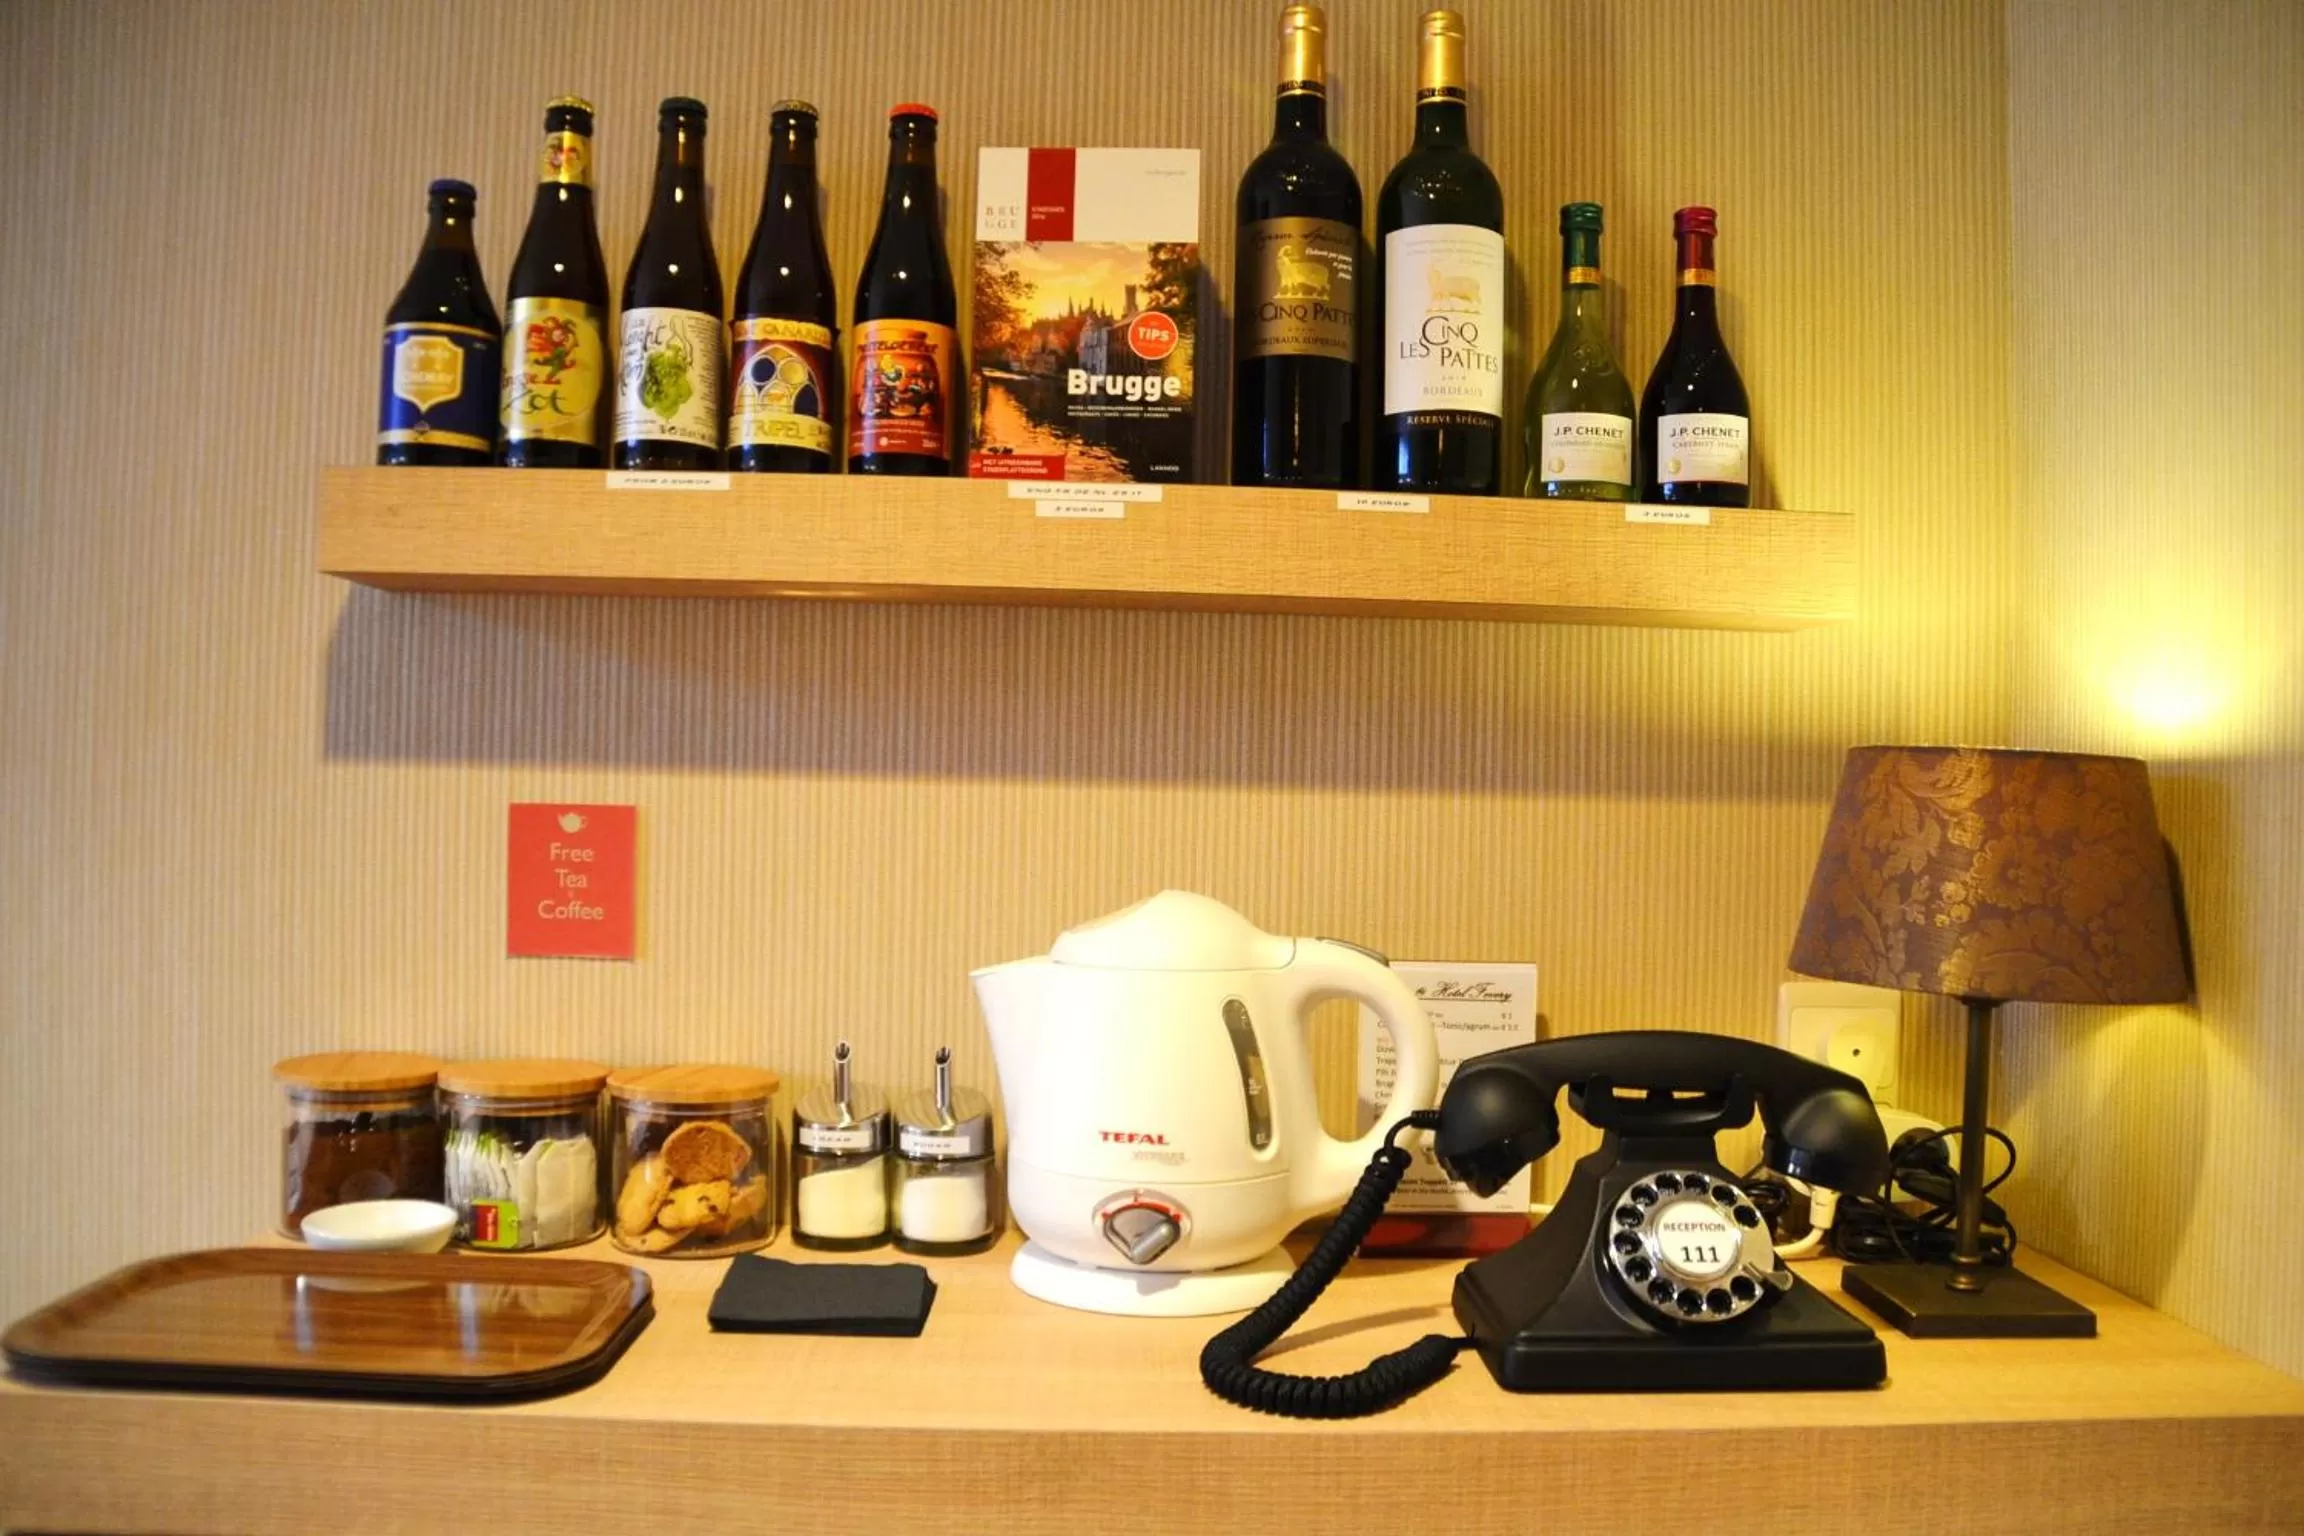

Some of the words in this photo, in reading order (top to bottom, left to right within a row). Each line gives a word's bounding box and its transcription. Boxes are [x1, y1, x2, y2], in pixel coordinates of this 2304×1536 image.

[1259, 302, 1308, 323] CINQ
[1138, 327, 1169, 342] TIPS
[1421, 315, 1479, 348] CINQ
[1400, 336, 1430, 359] LES
[1441, 347, 1498, 374] PATTES
[1067, 368, 1182, 402] Brugge
[1554, 427, 1572, 437] J.P.
[1576, 426, 1624, 439] CHENET
[1670, 427, 1689, 438] J.P.
[1692, 426, 1740, 438] CHENET
[549, 841, 595, 863] Free
[554, 868, 588, 889] Tea
[538, 899, 605, 920] Coffee
[1099, 1130, 1171, 1146] TEFAL
[1663, 1222, 1726, 1233] RECEPTION
[1681, 1246, 1721, 1264] 111
